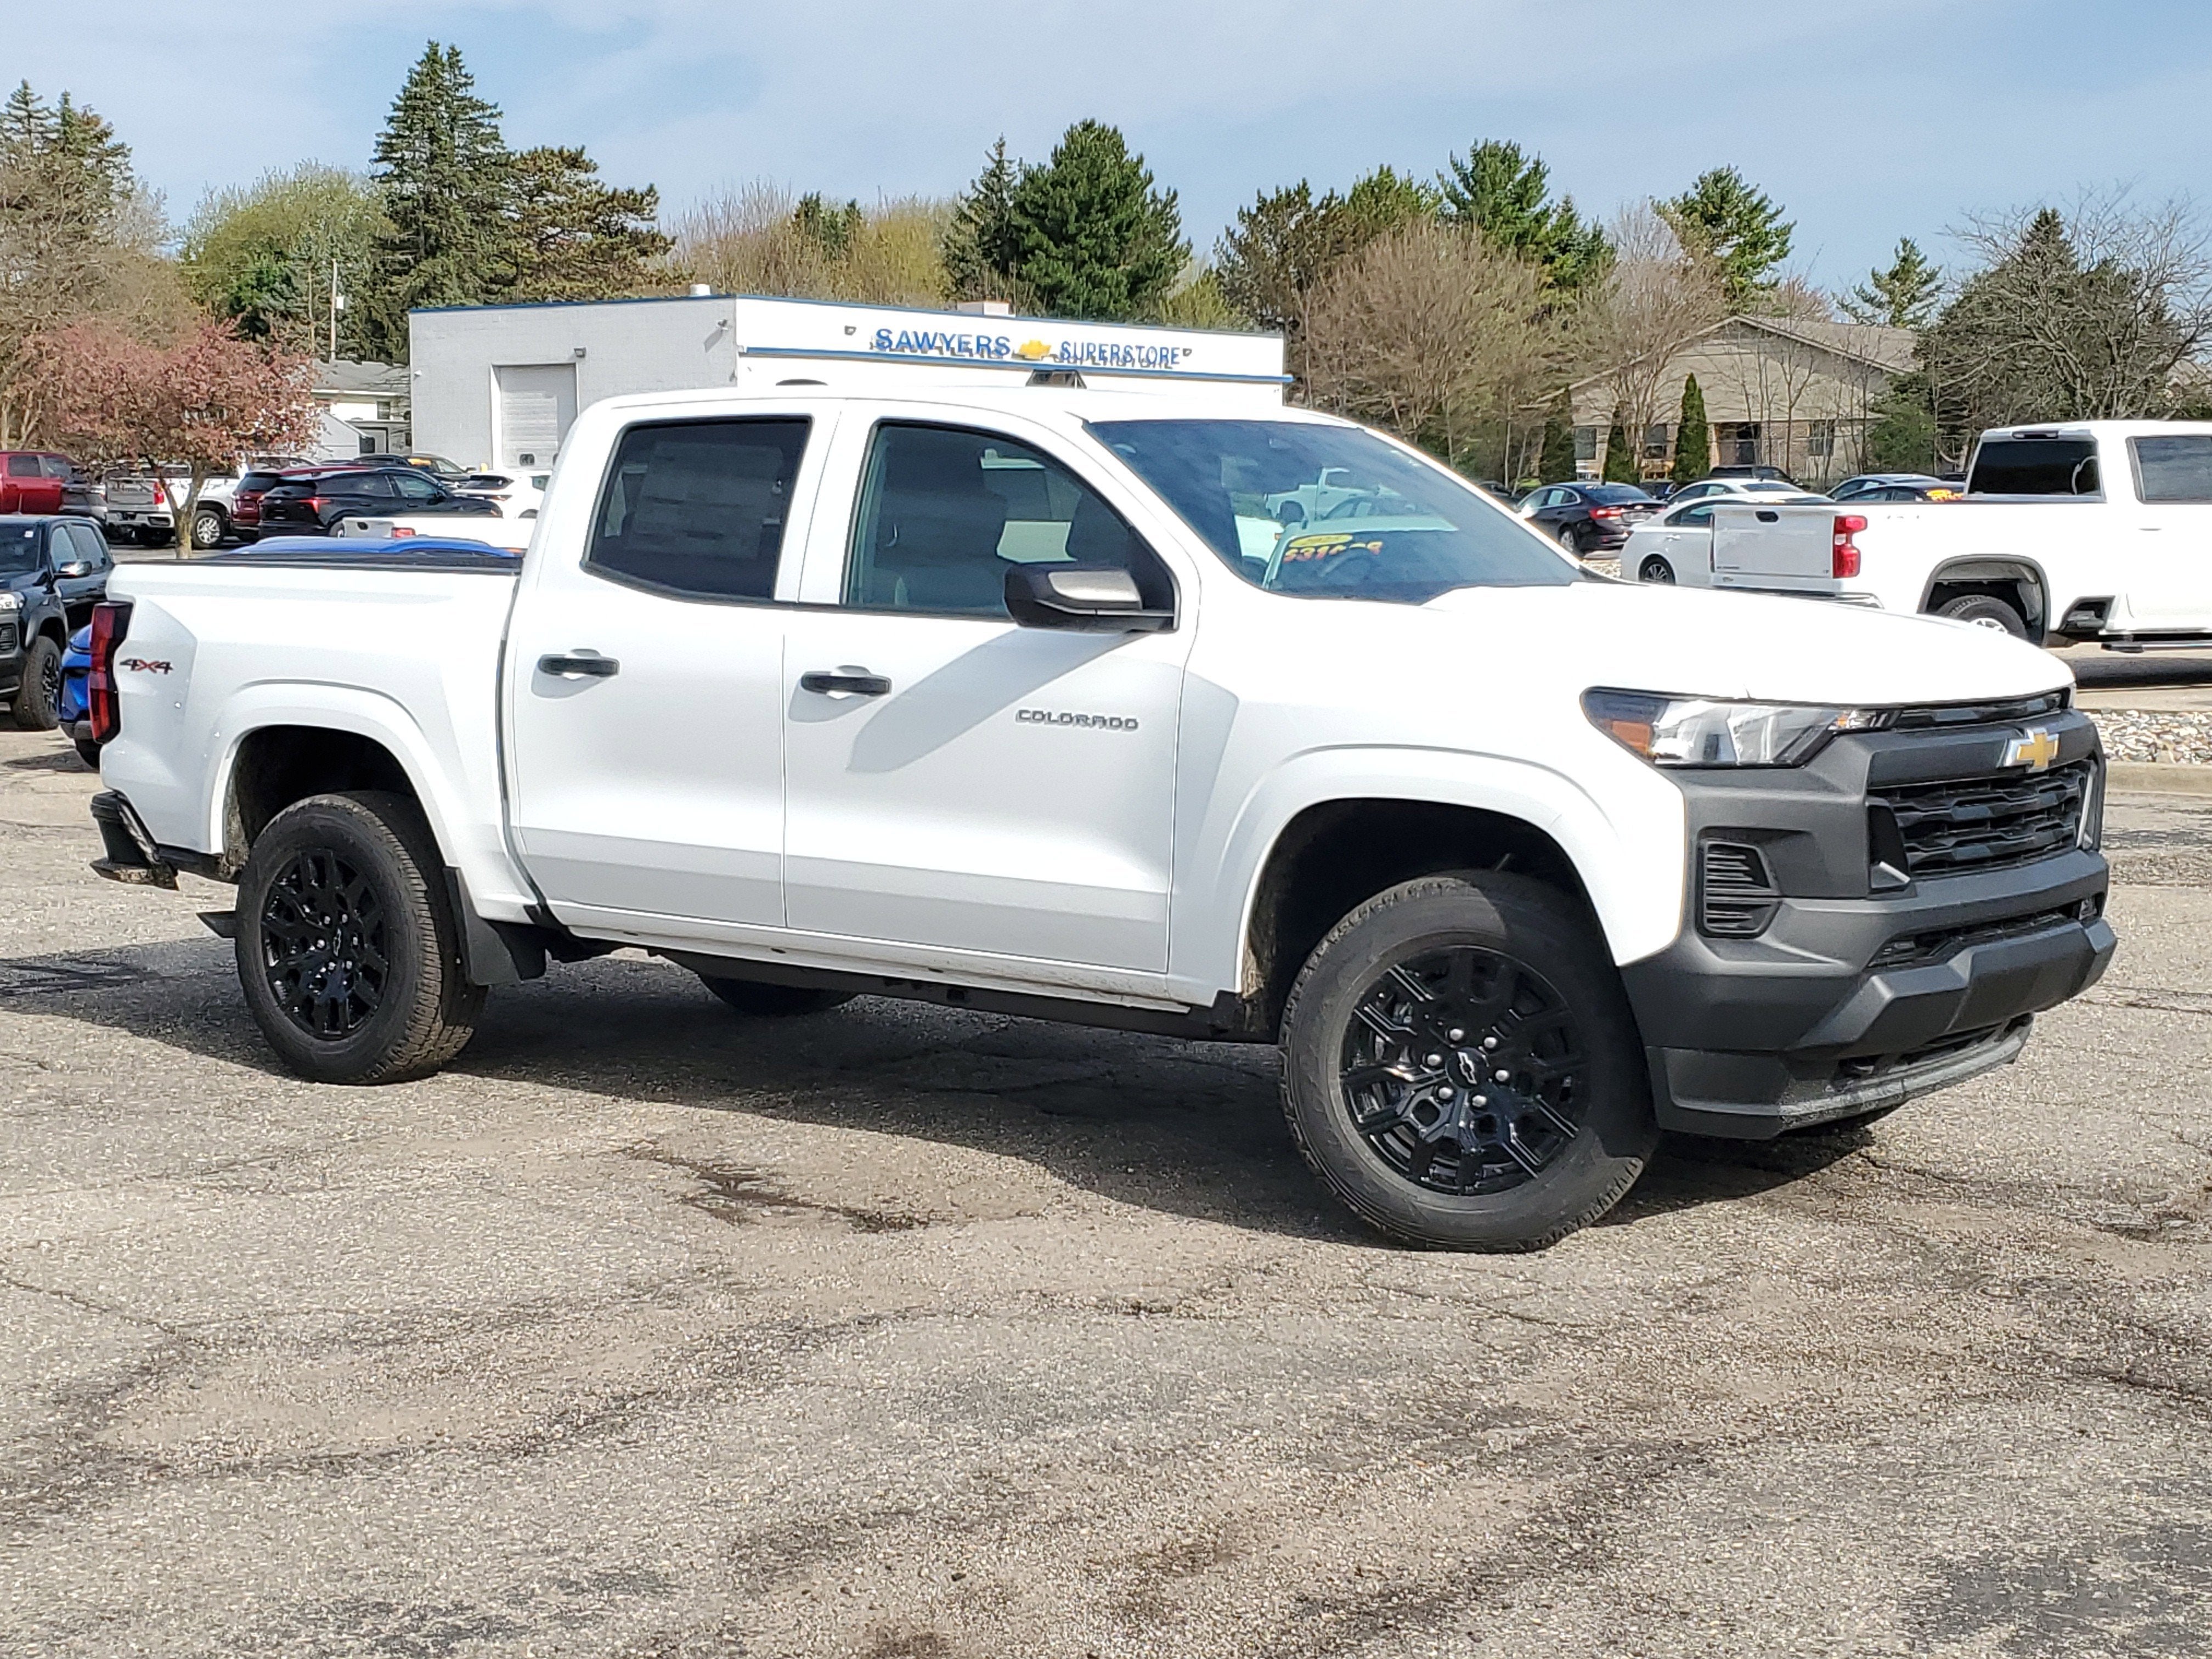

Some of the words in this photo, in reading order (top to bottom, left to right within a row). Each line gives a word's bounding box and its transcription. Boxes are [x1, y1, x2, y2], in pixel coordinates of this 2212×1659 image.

[876, 328, 1011, 356] SAWYERS
[1060, 341, 1180, 365] SUPERSTORE
[1016, 709, 1138, 730] COLORADO
